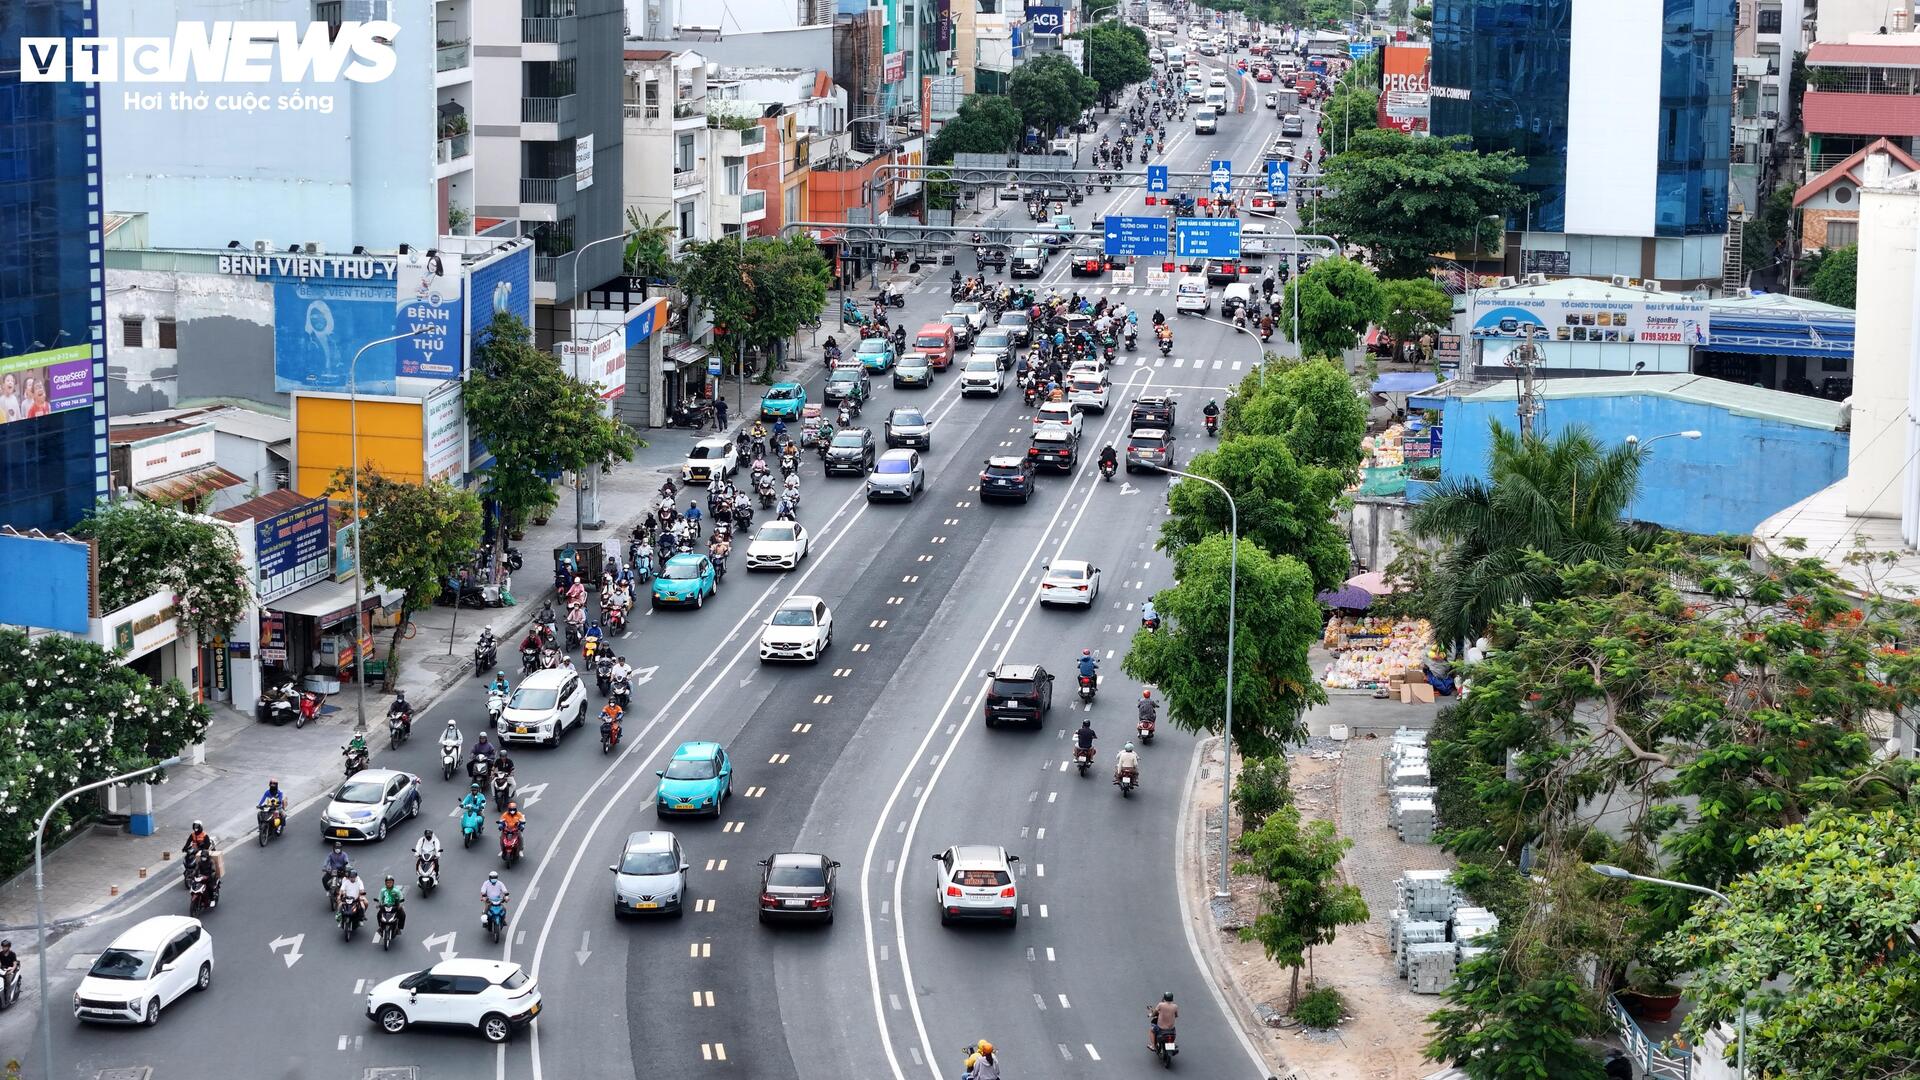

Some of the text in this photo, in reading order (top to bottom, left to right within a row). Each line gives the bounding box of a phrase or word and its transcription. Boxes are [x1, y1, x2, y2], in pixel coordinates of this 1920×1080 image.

[1034, 13, 1059, 26] ACB
[1430, 86, 1471, 101] STOCK COMPANY
[407, 305, 449, 321] BỆNH
[1646, 315, 1679, 325] SaigonBus
[1640, 331, 1681, 342] 0799.592.592
[413, 338, 444, 351] THÚ
[423, 352, 433, 362] Y
[53, 370, 87, 384] GrapeSEED
